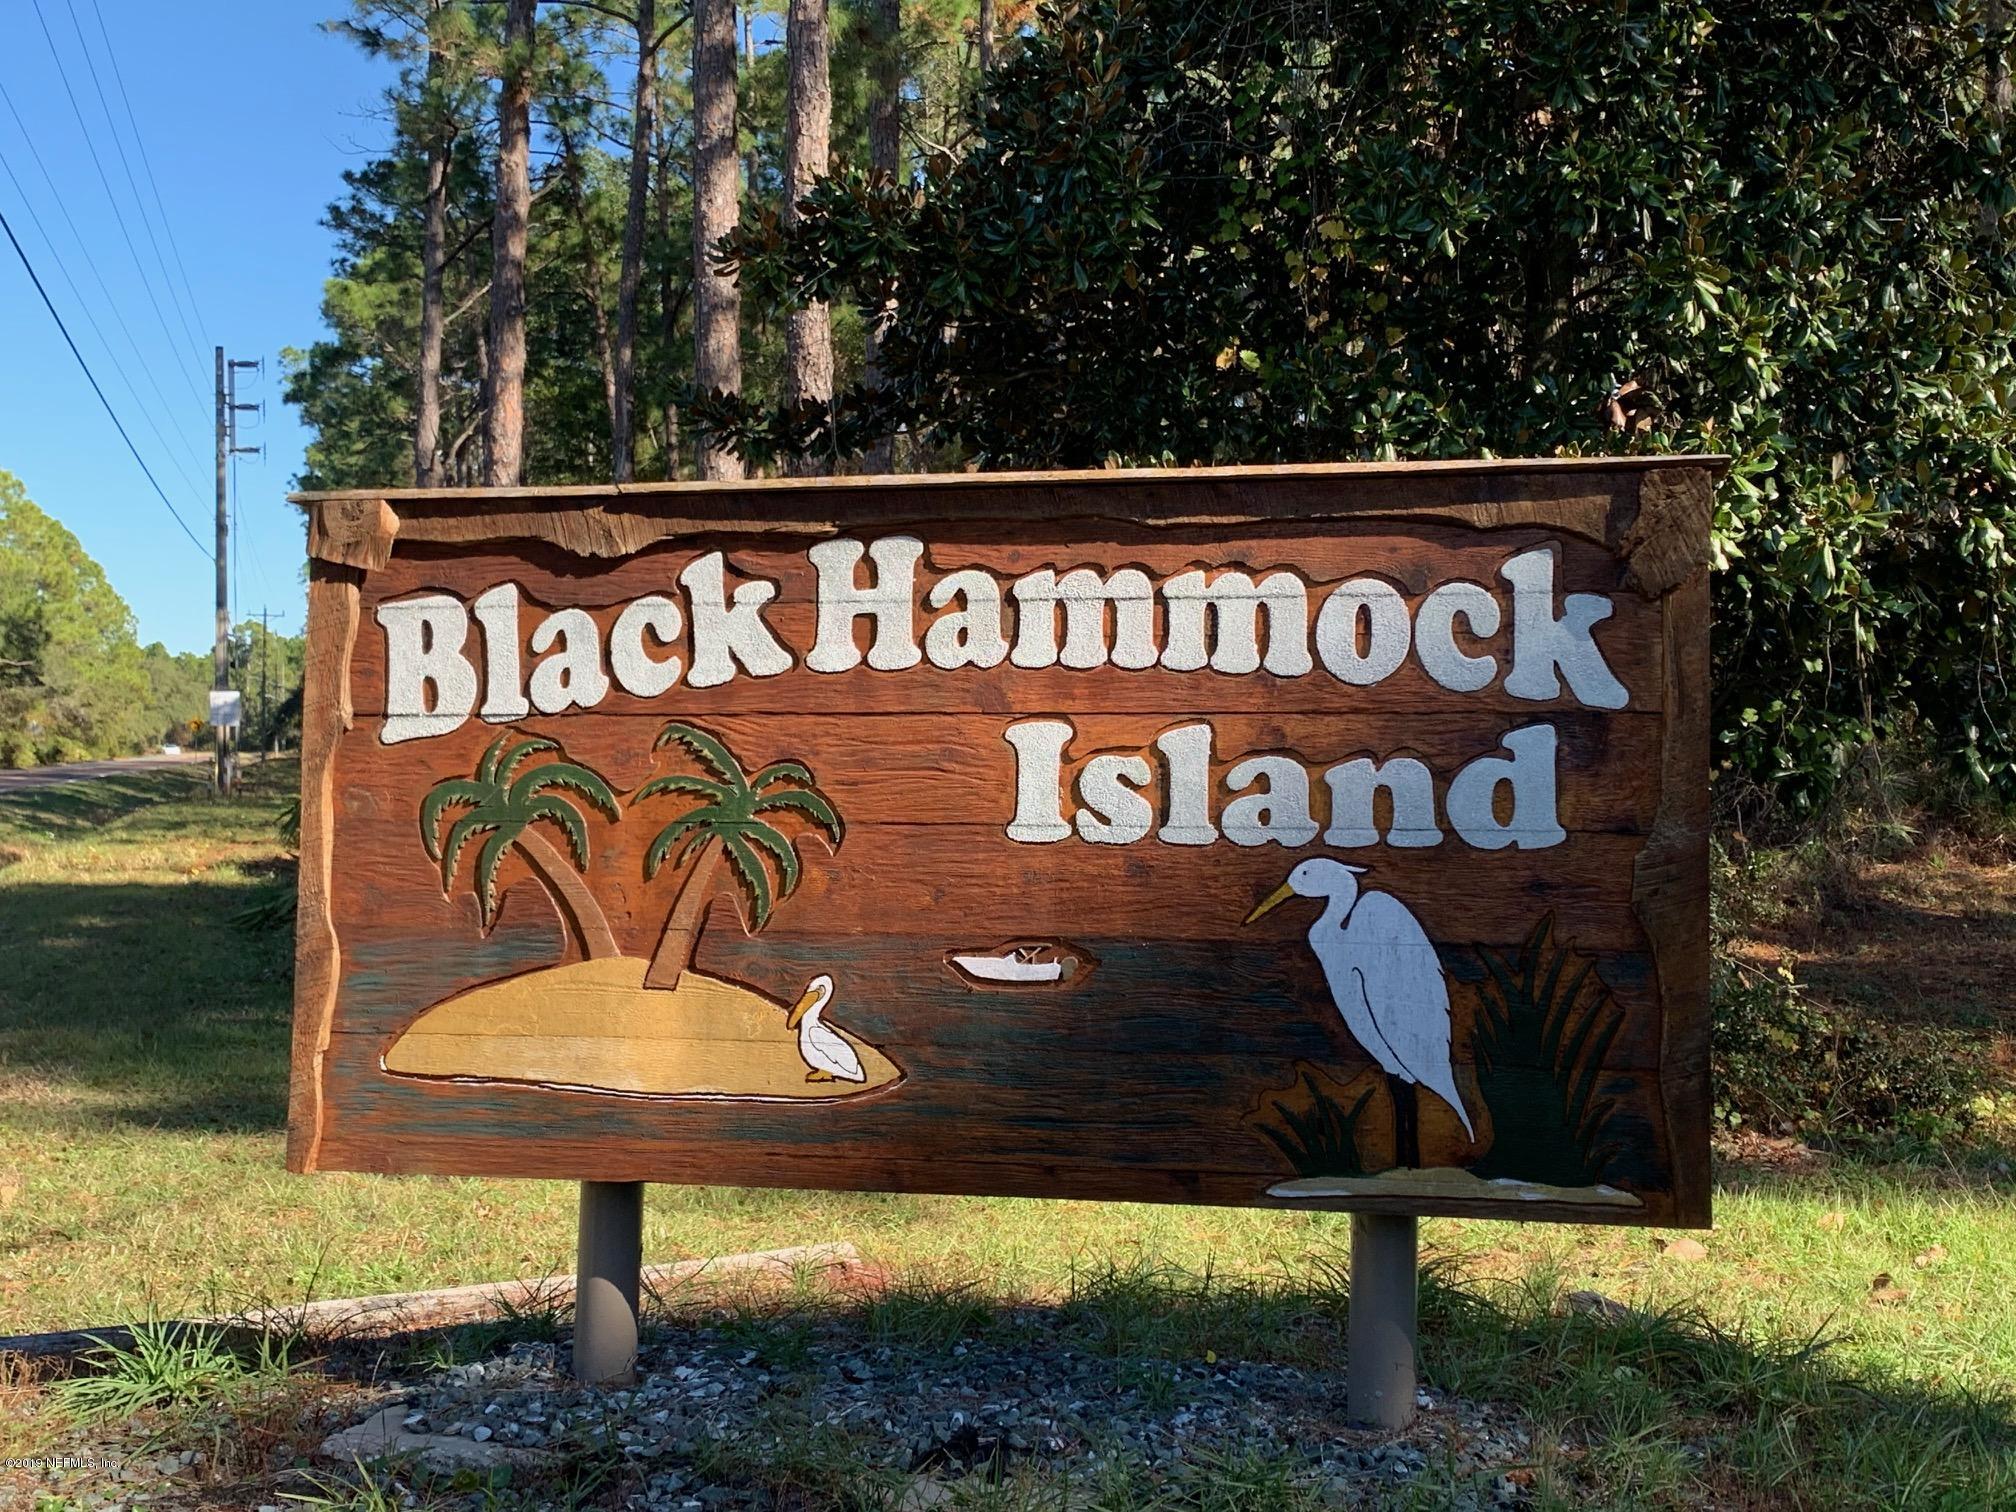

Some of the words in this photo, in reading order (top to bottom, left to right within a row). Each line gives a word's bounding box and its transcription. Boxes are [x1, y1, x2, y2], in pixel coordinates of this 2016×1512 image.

[377, 551, 794, 745] Black
[804, 536, 1630, 710] Hammock
[1005, 721, 1567, 850] Island
